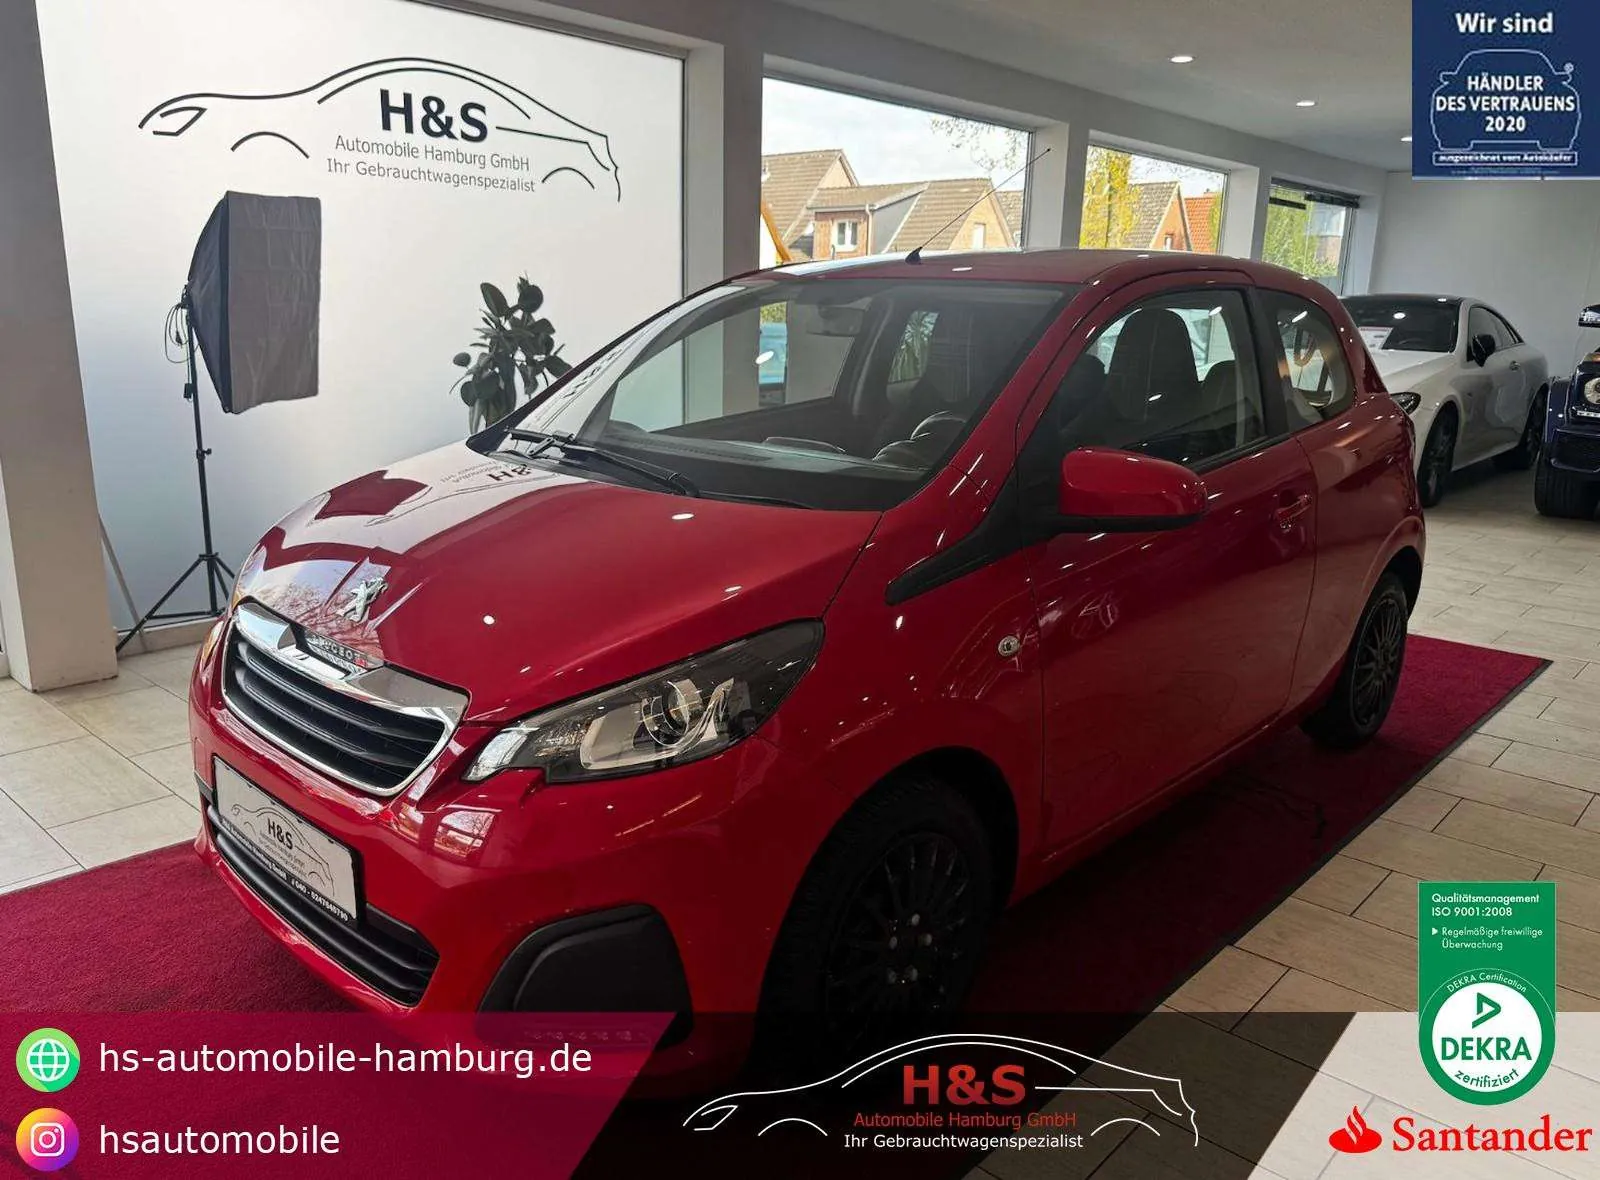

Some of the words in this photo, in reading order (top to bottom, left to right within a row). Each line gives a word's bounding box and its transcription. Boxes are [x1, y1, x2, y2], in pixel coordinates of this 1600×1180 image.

[380, 88, 488, 143] H&S
[335, 135, 420, 159] Automobile
[424, 144, 486, 169] Hamburg
[490, 153, 530, 171] GmbH
[327, 158, 350, 174] Ihr
[355, 161, 536, 193] Gebrauchtwagenspezialist
[267, 817, 294, 850] H&S
